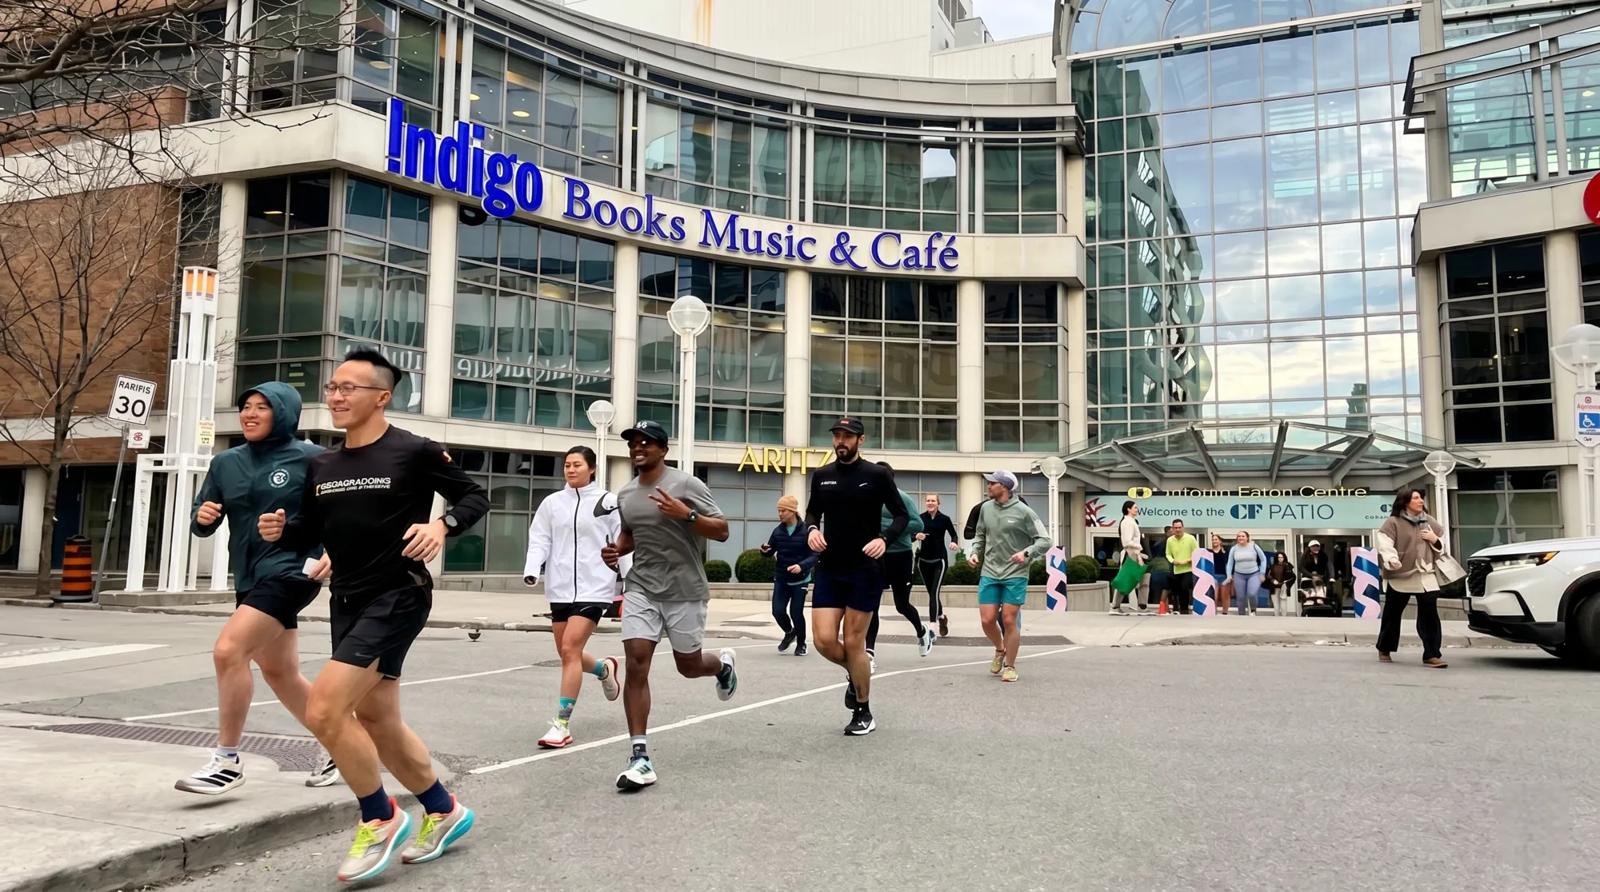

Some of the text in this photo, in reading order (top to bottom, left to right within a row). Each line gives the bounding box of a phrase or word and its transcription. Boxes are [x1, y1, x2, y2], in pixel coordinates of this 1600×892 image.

[563, 176, 687, 243] Books
[698, 208, 818, 263] Music
[828, 230, 868, 271] &
[870, 230, 961, 272] Café
[115, 396, 146, 417] 30
[1238, 485, 1293, 498] Eaton
[1299, 485, 1368, 498] Centre
[1137, 503, 1335, 520] Welcome to the CF PATIO
